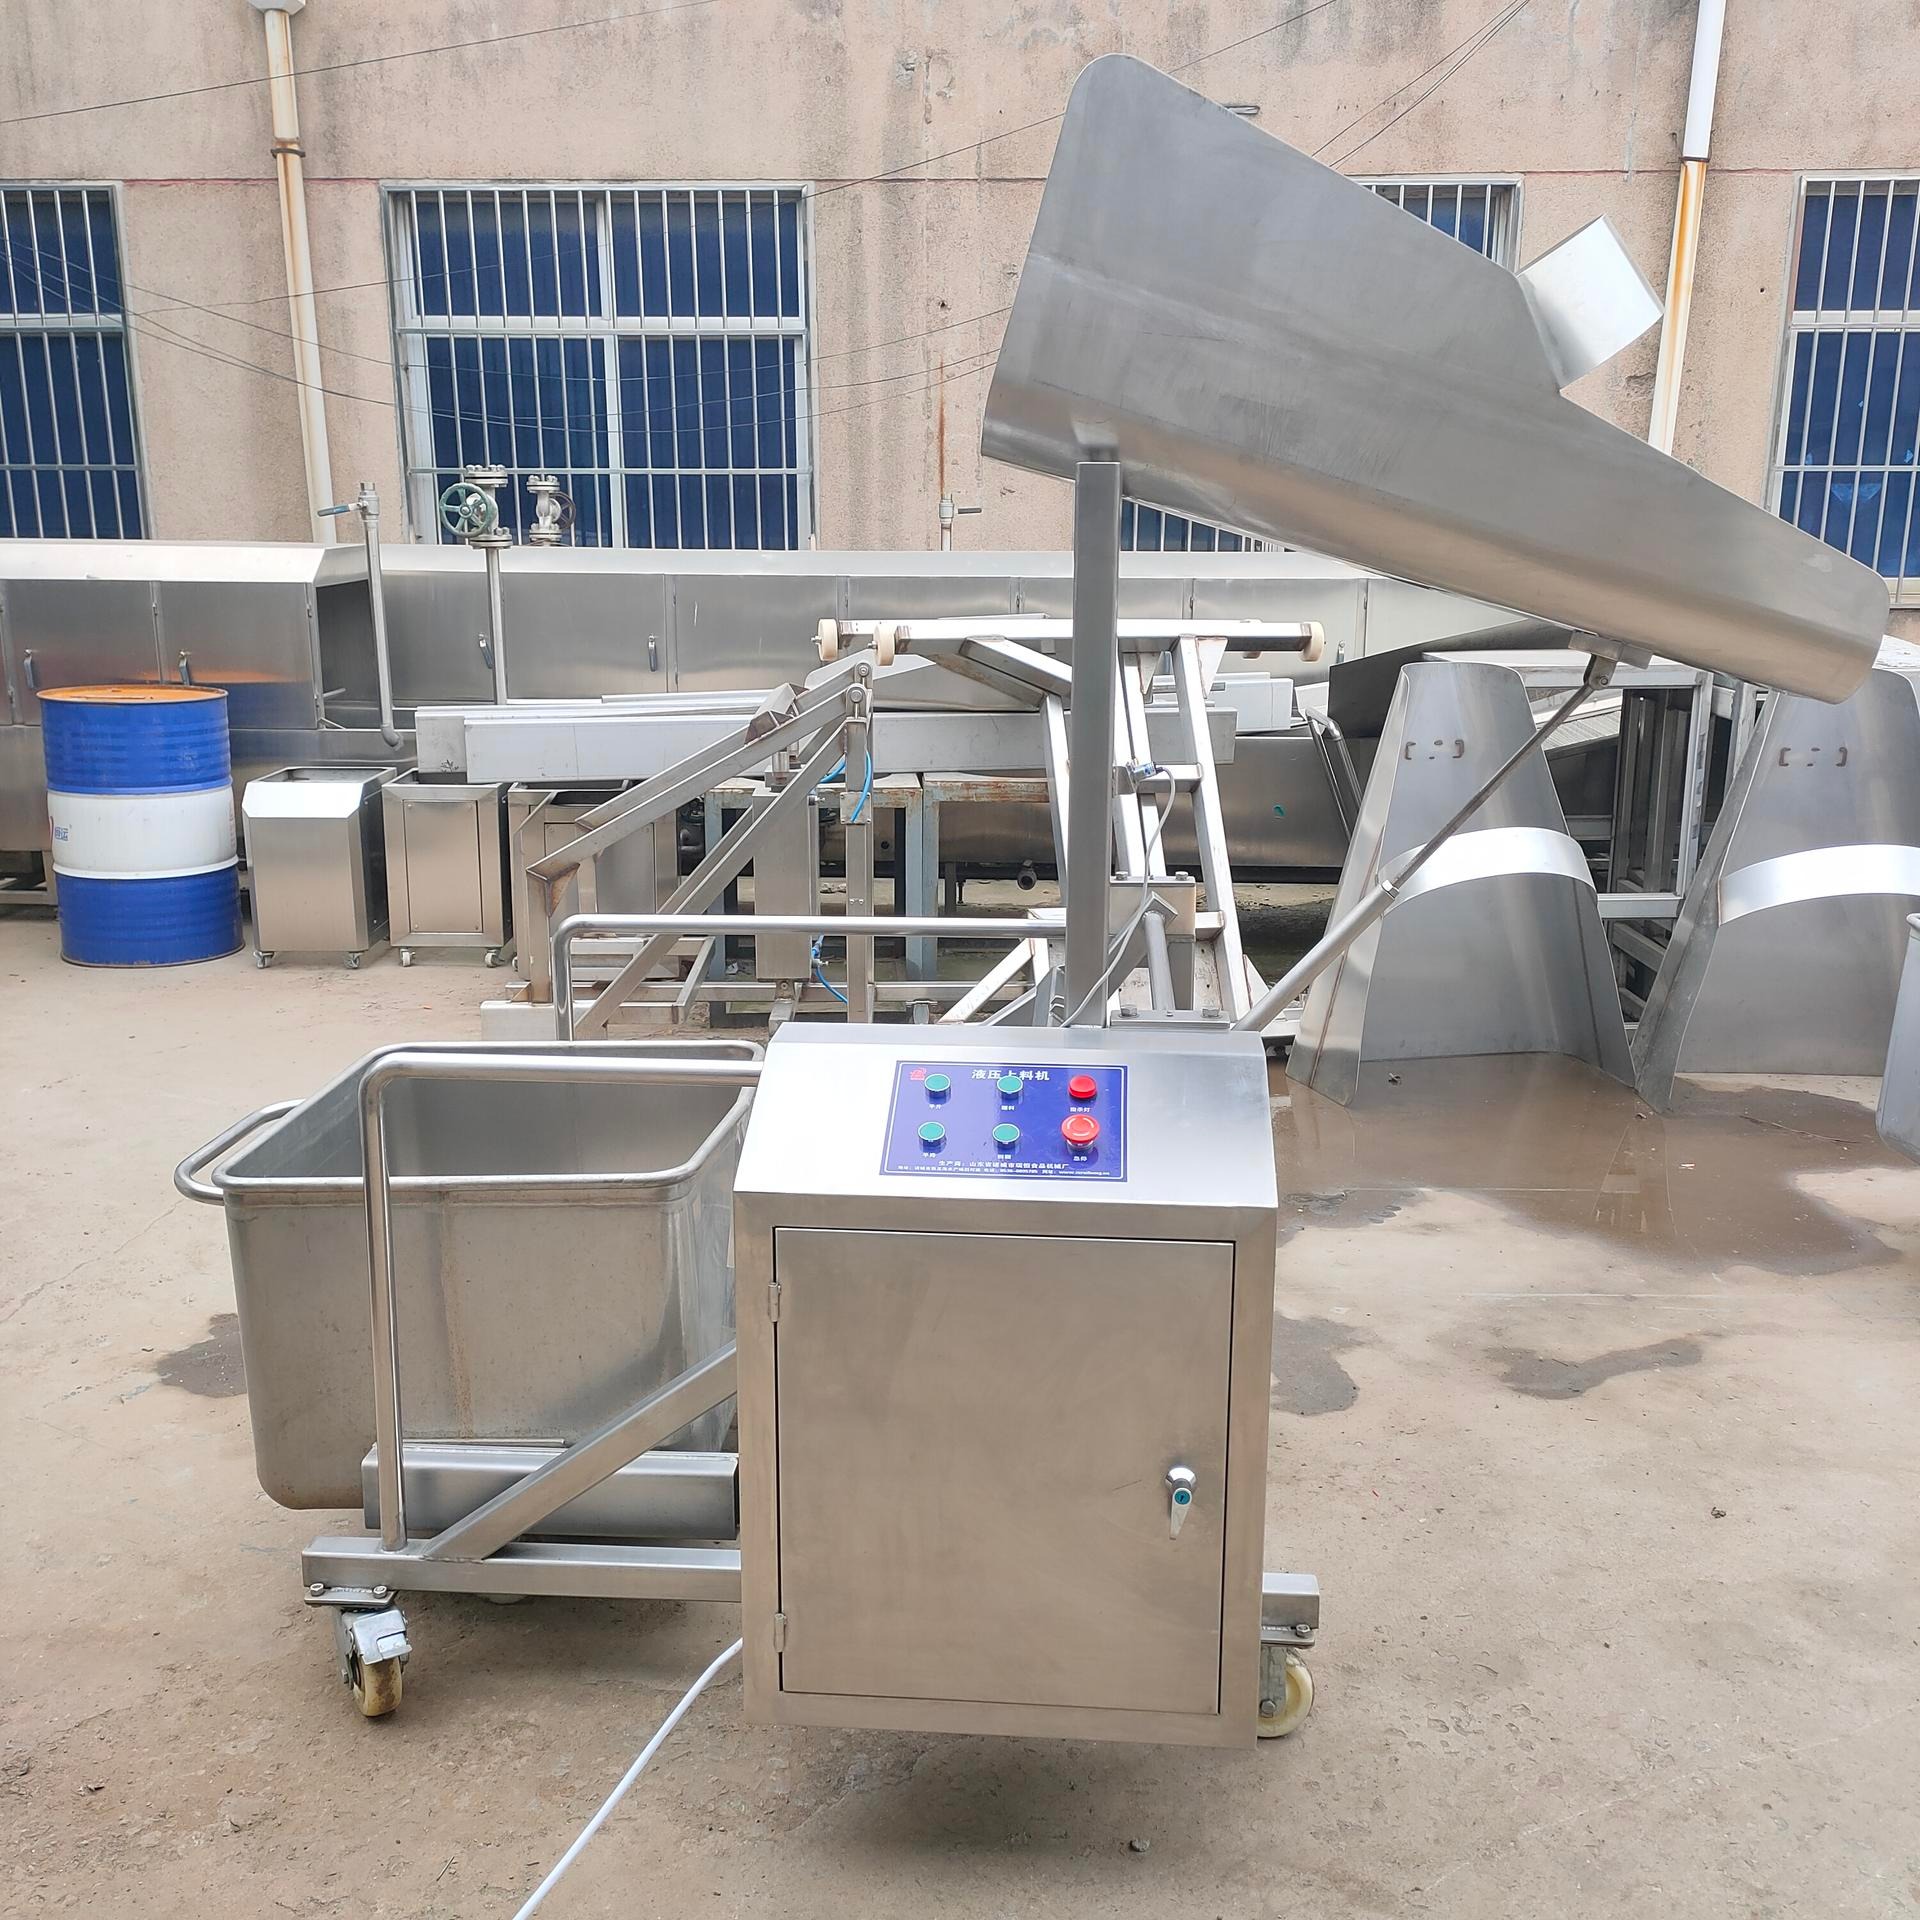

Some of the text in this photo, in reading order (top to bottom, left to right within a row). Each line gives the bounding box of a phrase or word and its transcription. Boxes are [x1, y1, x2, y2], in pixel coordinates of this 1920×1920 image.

[972, 1069, 1050, 1081] 液压上料机
